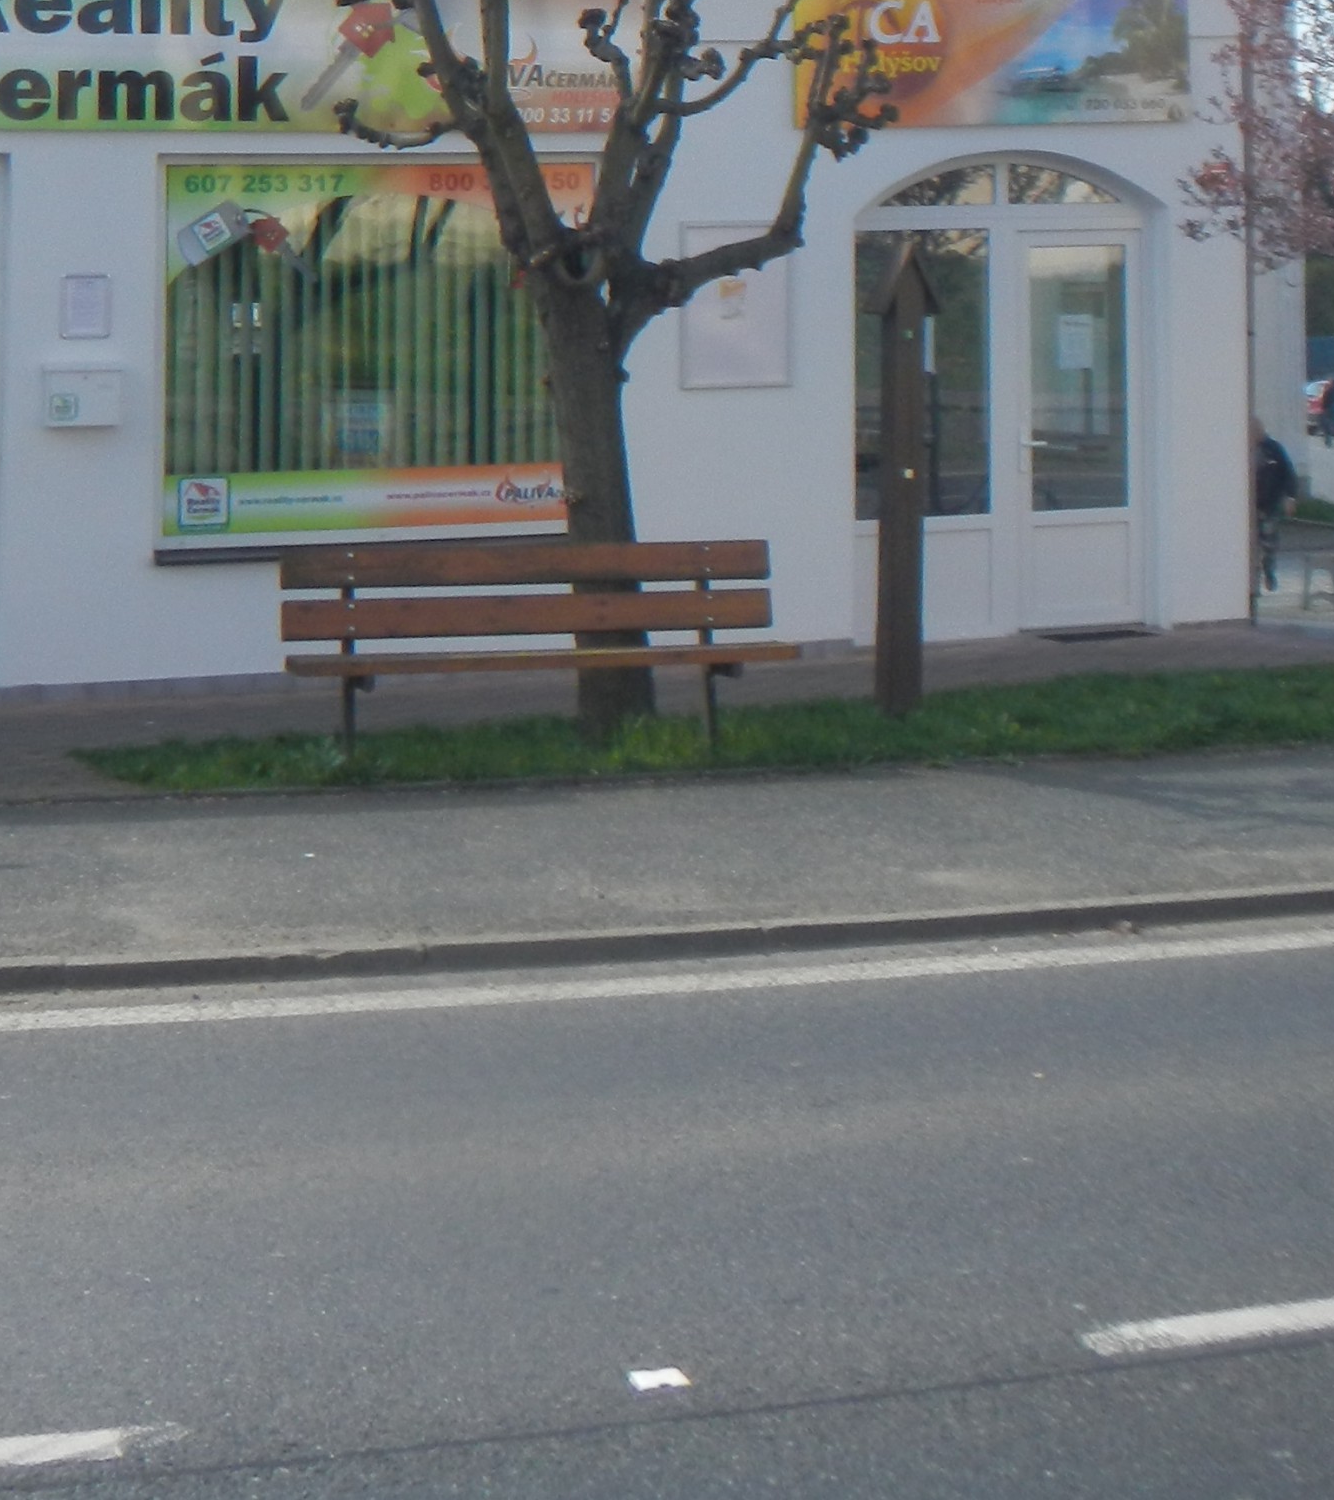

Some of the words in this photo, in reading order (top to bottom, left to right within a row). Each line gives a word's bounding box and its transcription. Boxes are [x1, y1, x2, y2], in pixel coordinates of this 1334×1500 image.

[869, 0, 942, 44] CA
[549, 107, 571, 124] 33
[576, 107, 594, 123] 11
[600, 107, 614, 124] 5
[184, 174, 231, 194] 607
[241, 174, 288, 193] 253
[298, 174, 344, 192] 317
[429, 173, 475, 192] 800
